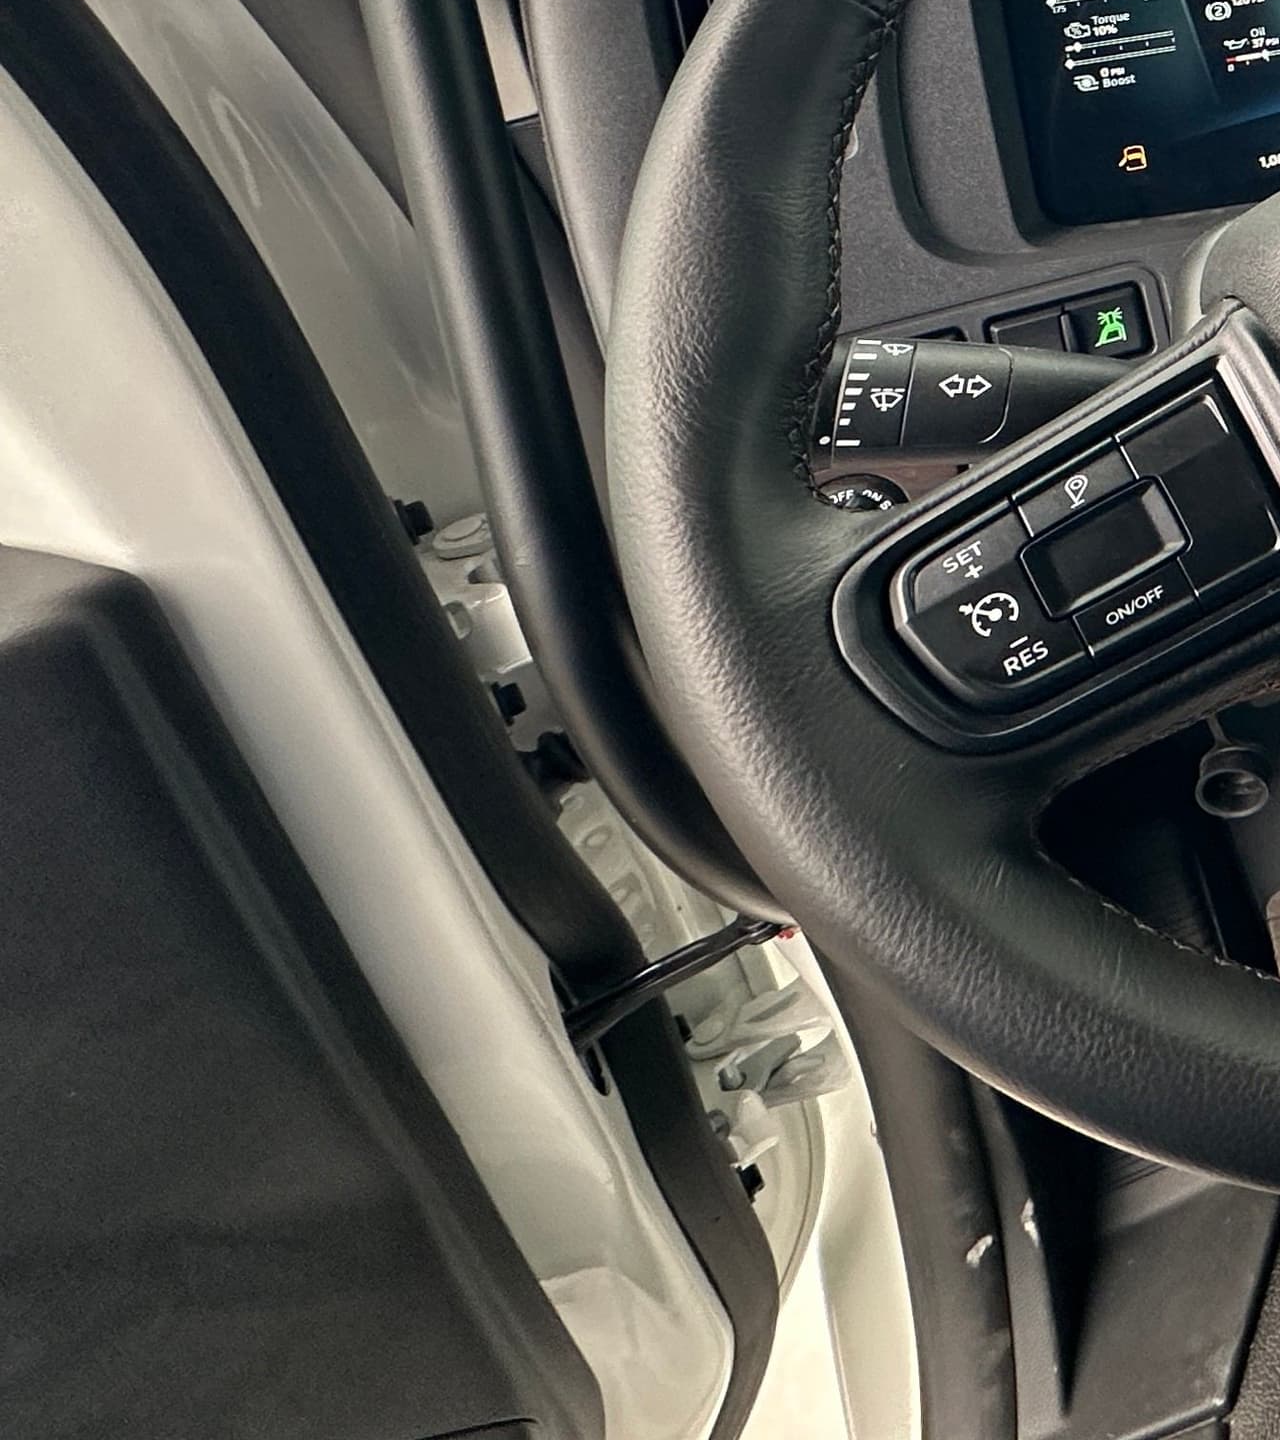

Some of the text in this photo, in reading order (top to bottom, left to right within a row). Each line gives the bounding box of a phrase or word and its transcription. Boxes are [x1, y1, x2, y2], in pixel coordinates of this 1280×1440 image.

[1091, 12, 1130, 25] Torque
[1093, 24, 1118, 36] 10%
[1250, 27, 1266, 38] Oil
[1103, 74, 1136, 88] Boost
[862, 489, 882, 501] ON
[942, 541, 983, 574] SET
[1105, 585, 1165, 626] ON/OFF
[1003, 641, 1049, 677] RES
